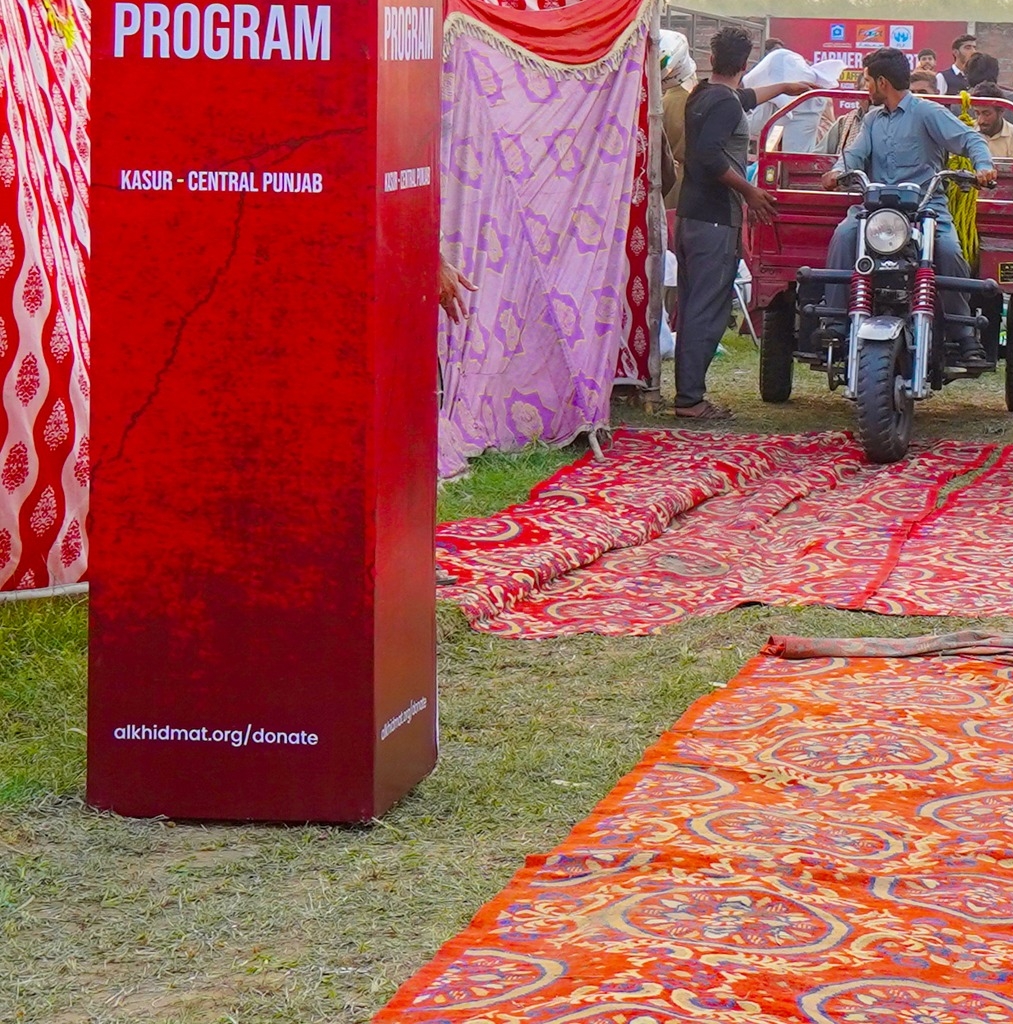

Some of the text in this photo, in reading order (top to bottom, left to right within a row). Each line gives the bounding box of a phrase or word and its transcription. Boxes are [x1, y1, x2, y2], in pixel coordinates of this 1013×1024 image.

[114, 3, 330, 60] PROGRAM
[385, 7, 433, 60] PROGRAM
[839, 100, 860, 109] Fast
[122, 170, 172, 190] KASUR
[189, 171, 258, 192] CENTRAL
[263, 173, 322, 193] PUNJAB
[114, 724, 318, 747] alkhidmat.org/donate
